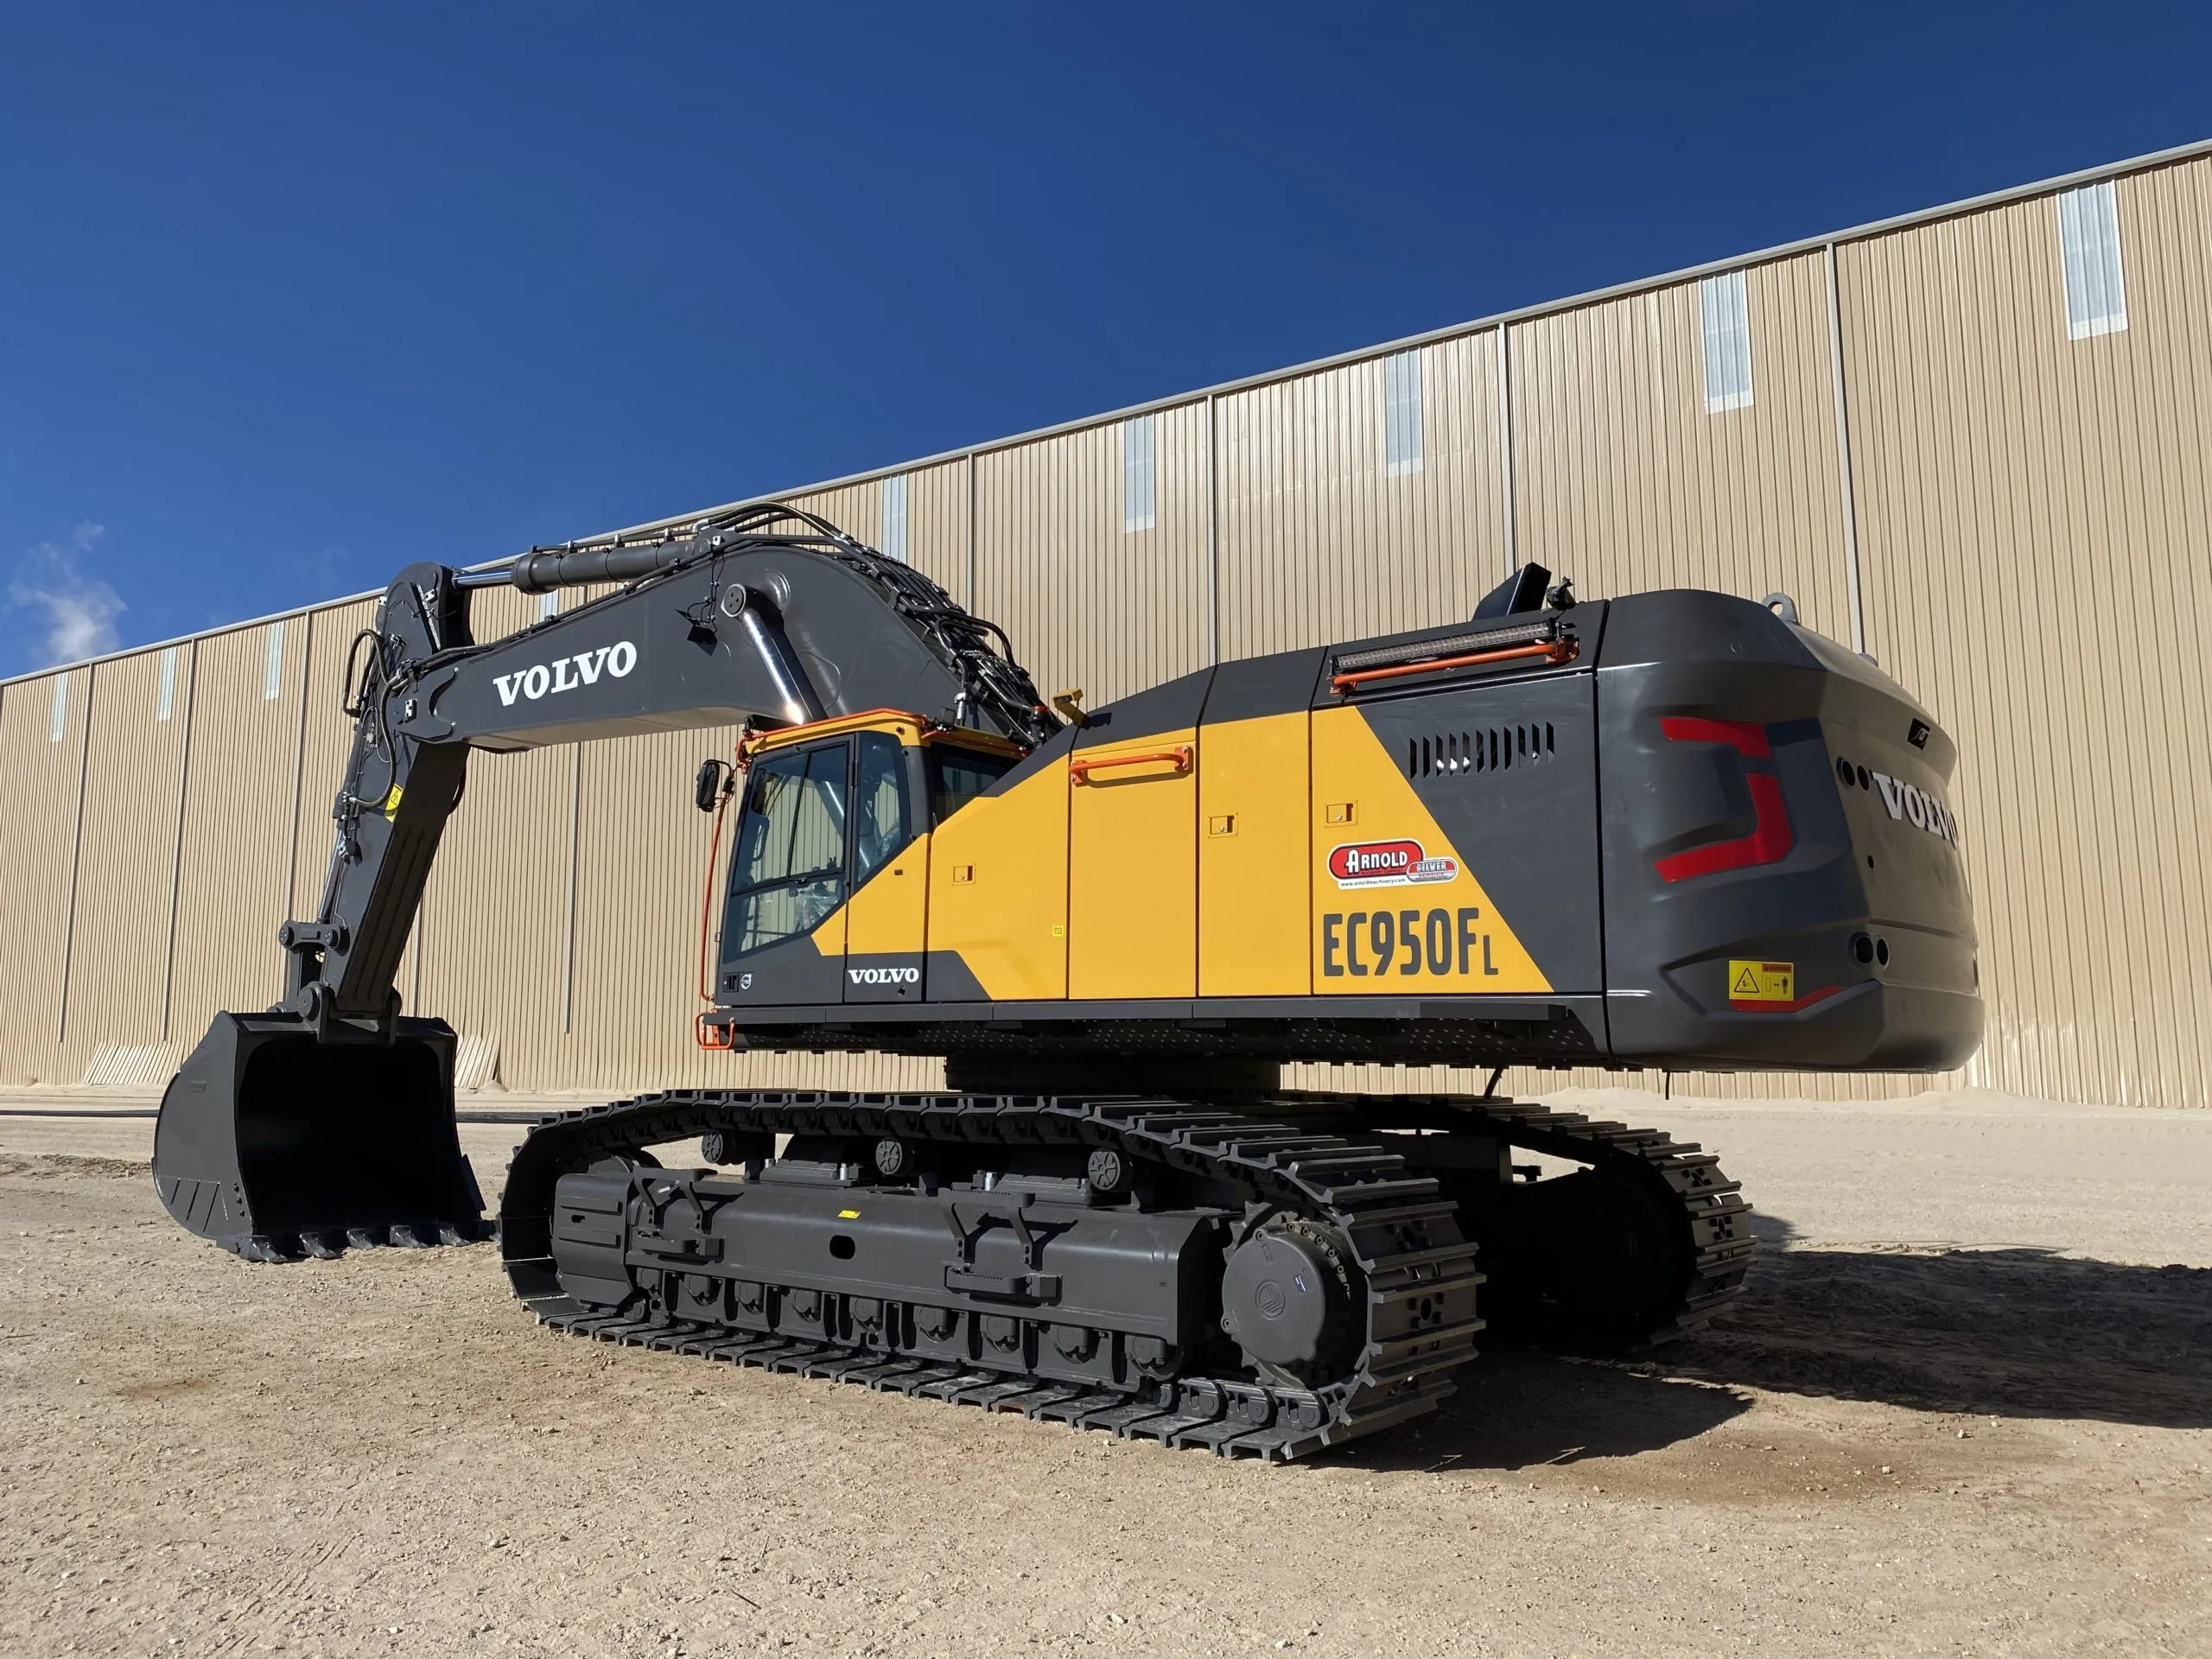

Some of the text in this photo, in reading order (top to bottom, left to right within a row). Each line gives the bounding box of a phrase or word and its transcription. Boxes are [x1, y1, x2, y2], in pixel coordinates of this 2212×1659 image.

[493, 640, 638, 707] VOLVO
[1872, 771, 1959, 850] VOLVO
[1416, 861, 1446, 872] SILVER
[848, 968, 919, 984] VOLVO
